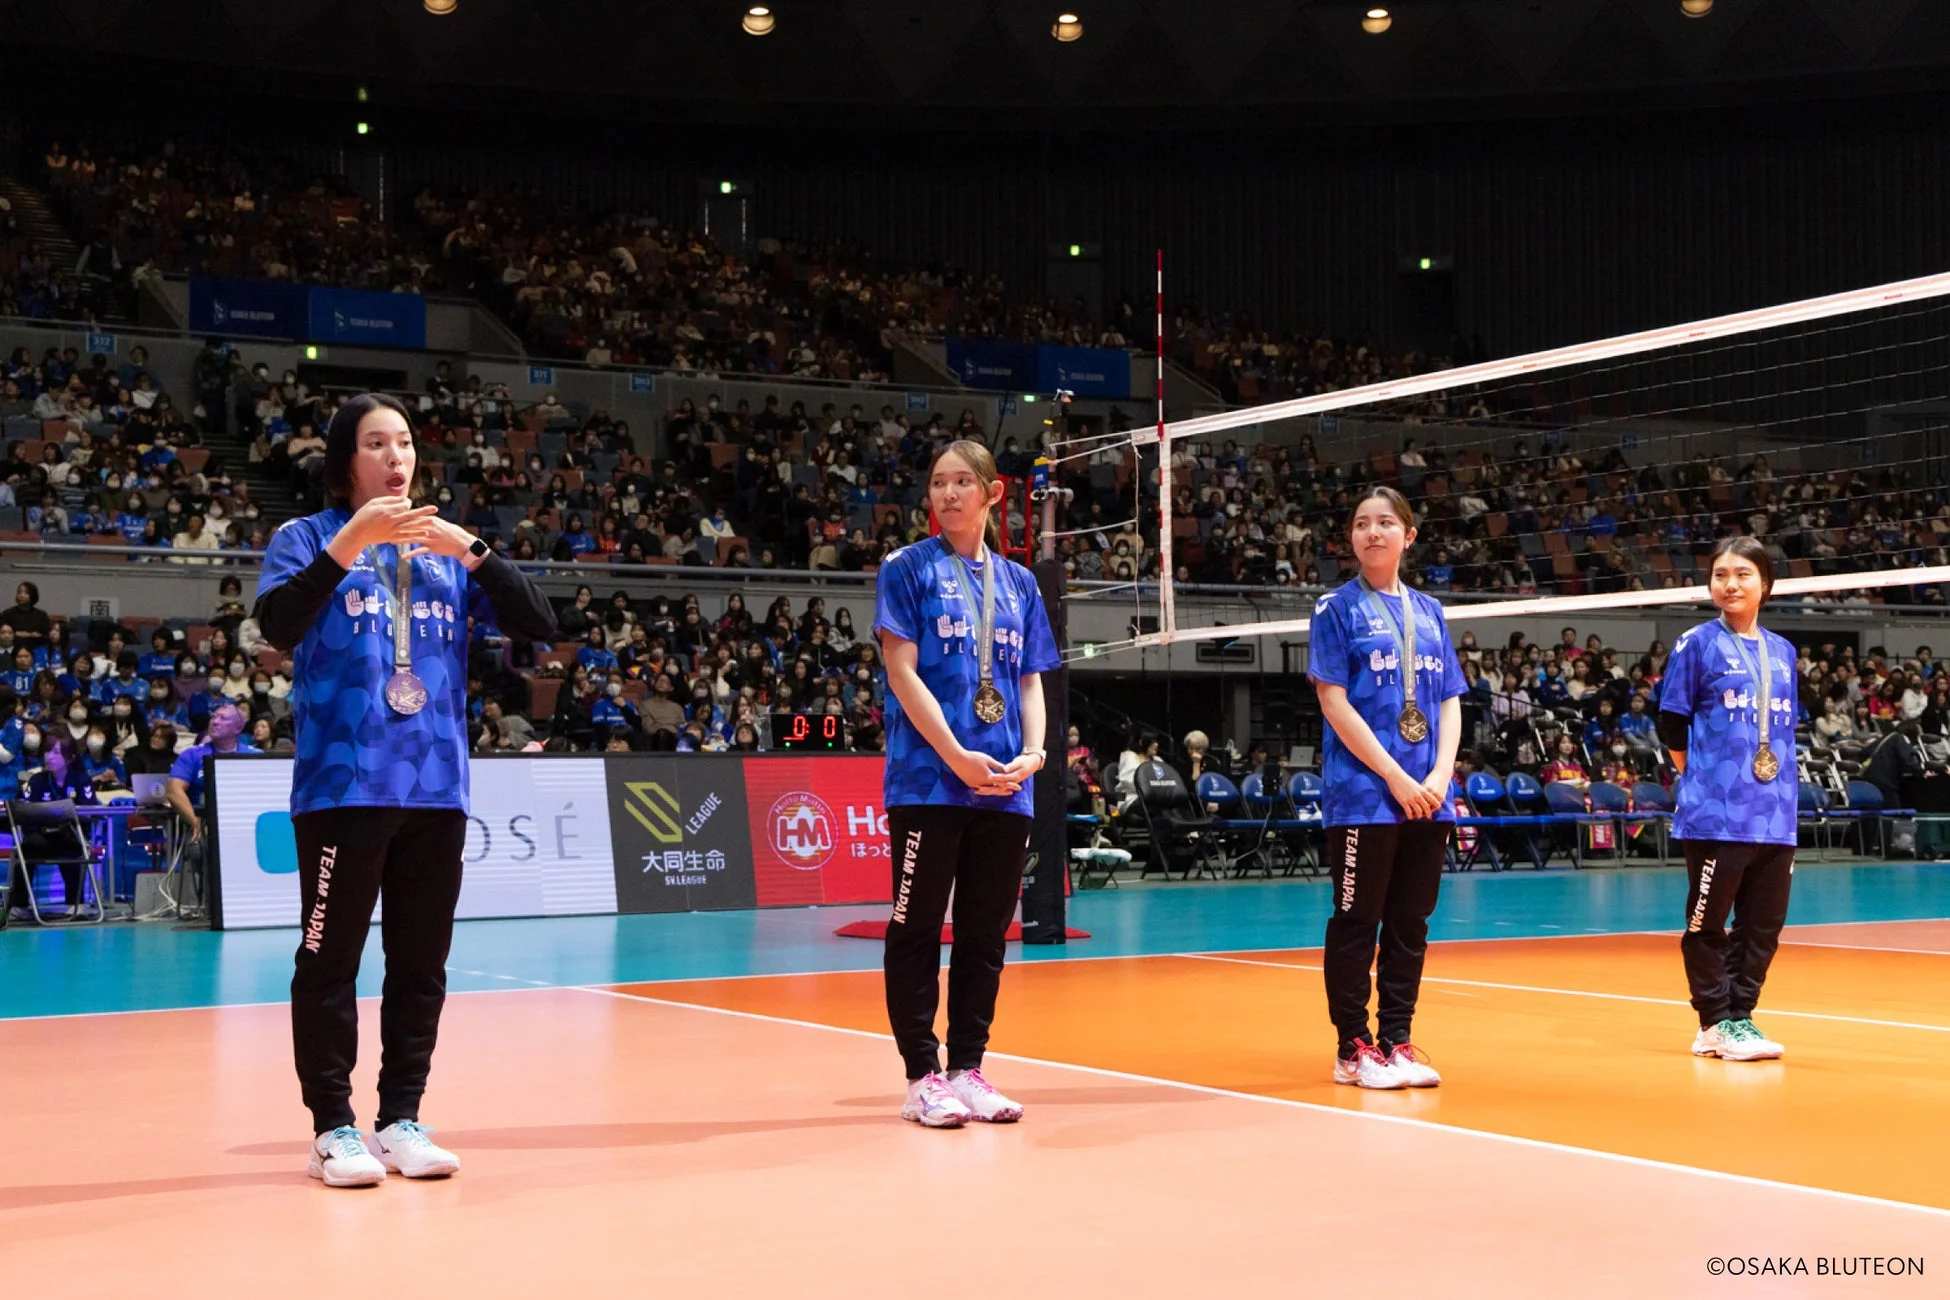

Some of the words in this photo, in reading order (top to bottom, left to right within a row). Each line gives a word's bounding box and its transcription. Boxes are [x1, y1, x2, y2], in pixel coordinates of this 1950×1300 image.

[684, 791, 722, 835] LEAGUE
[641, 849, 726, 874] 大同生命
[903, 830, 922, 875] TEAM
[1344, 828, 1359, 868] TEAM
[317, 845, 337, 898] TEAM
[664, 875, 707, 886] SV.LEAGUE
[1341, 868, 1356, 912] JAPAN
[1699, 859, 1717, 895] TEAM
[893, 874, 912, 924] JAPAN
[305, 897, 326, 954] JAPAN
